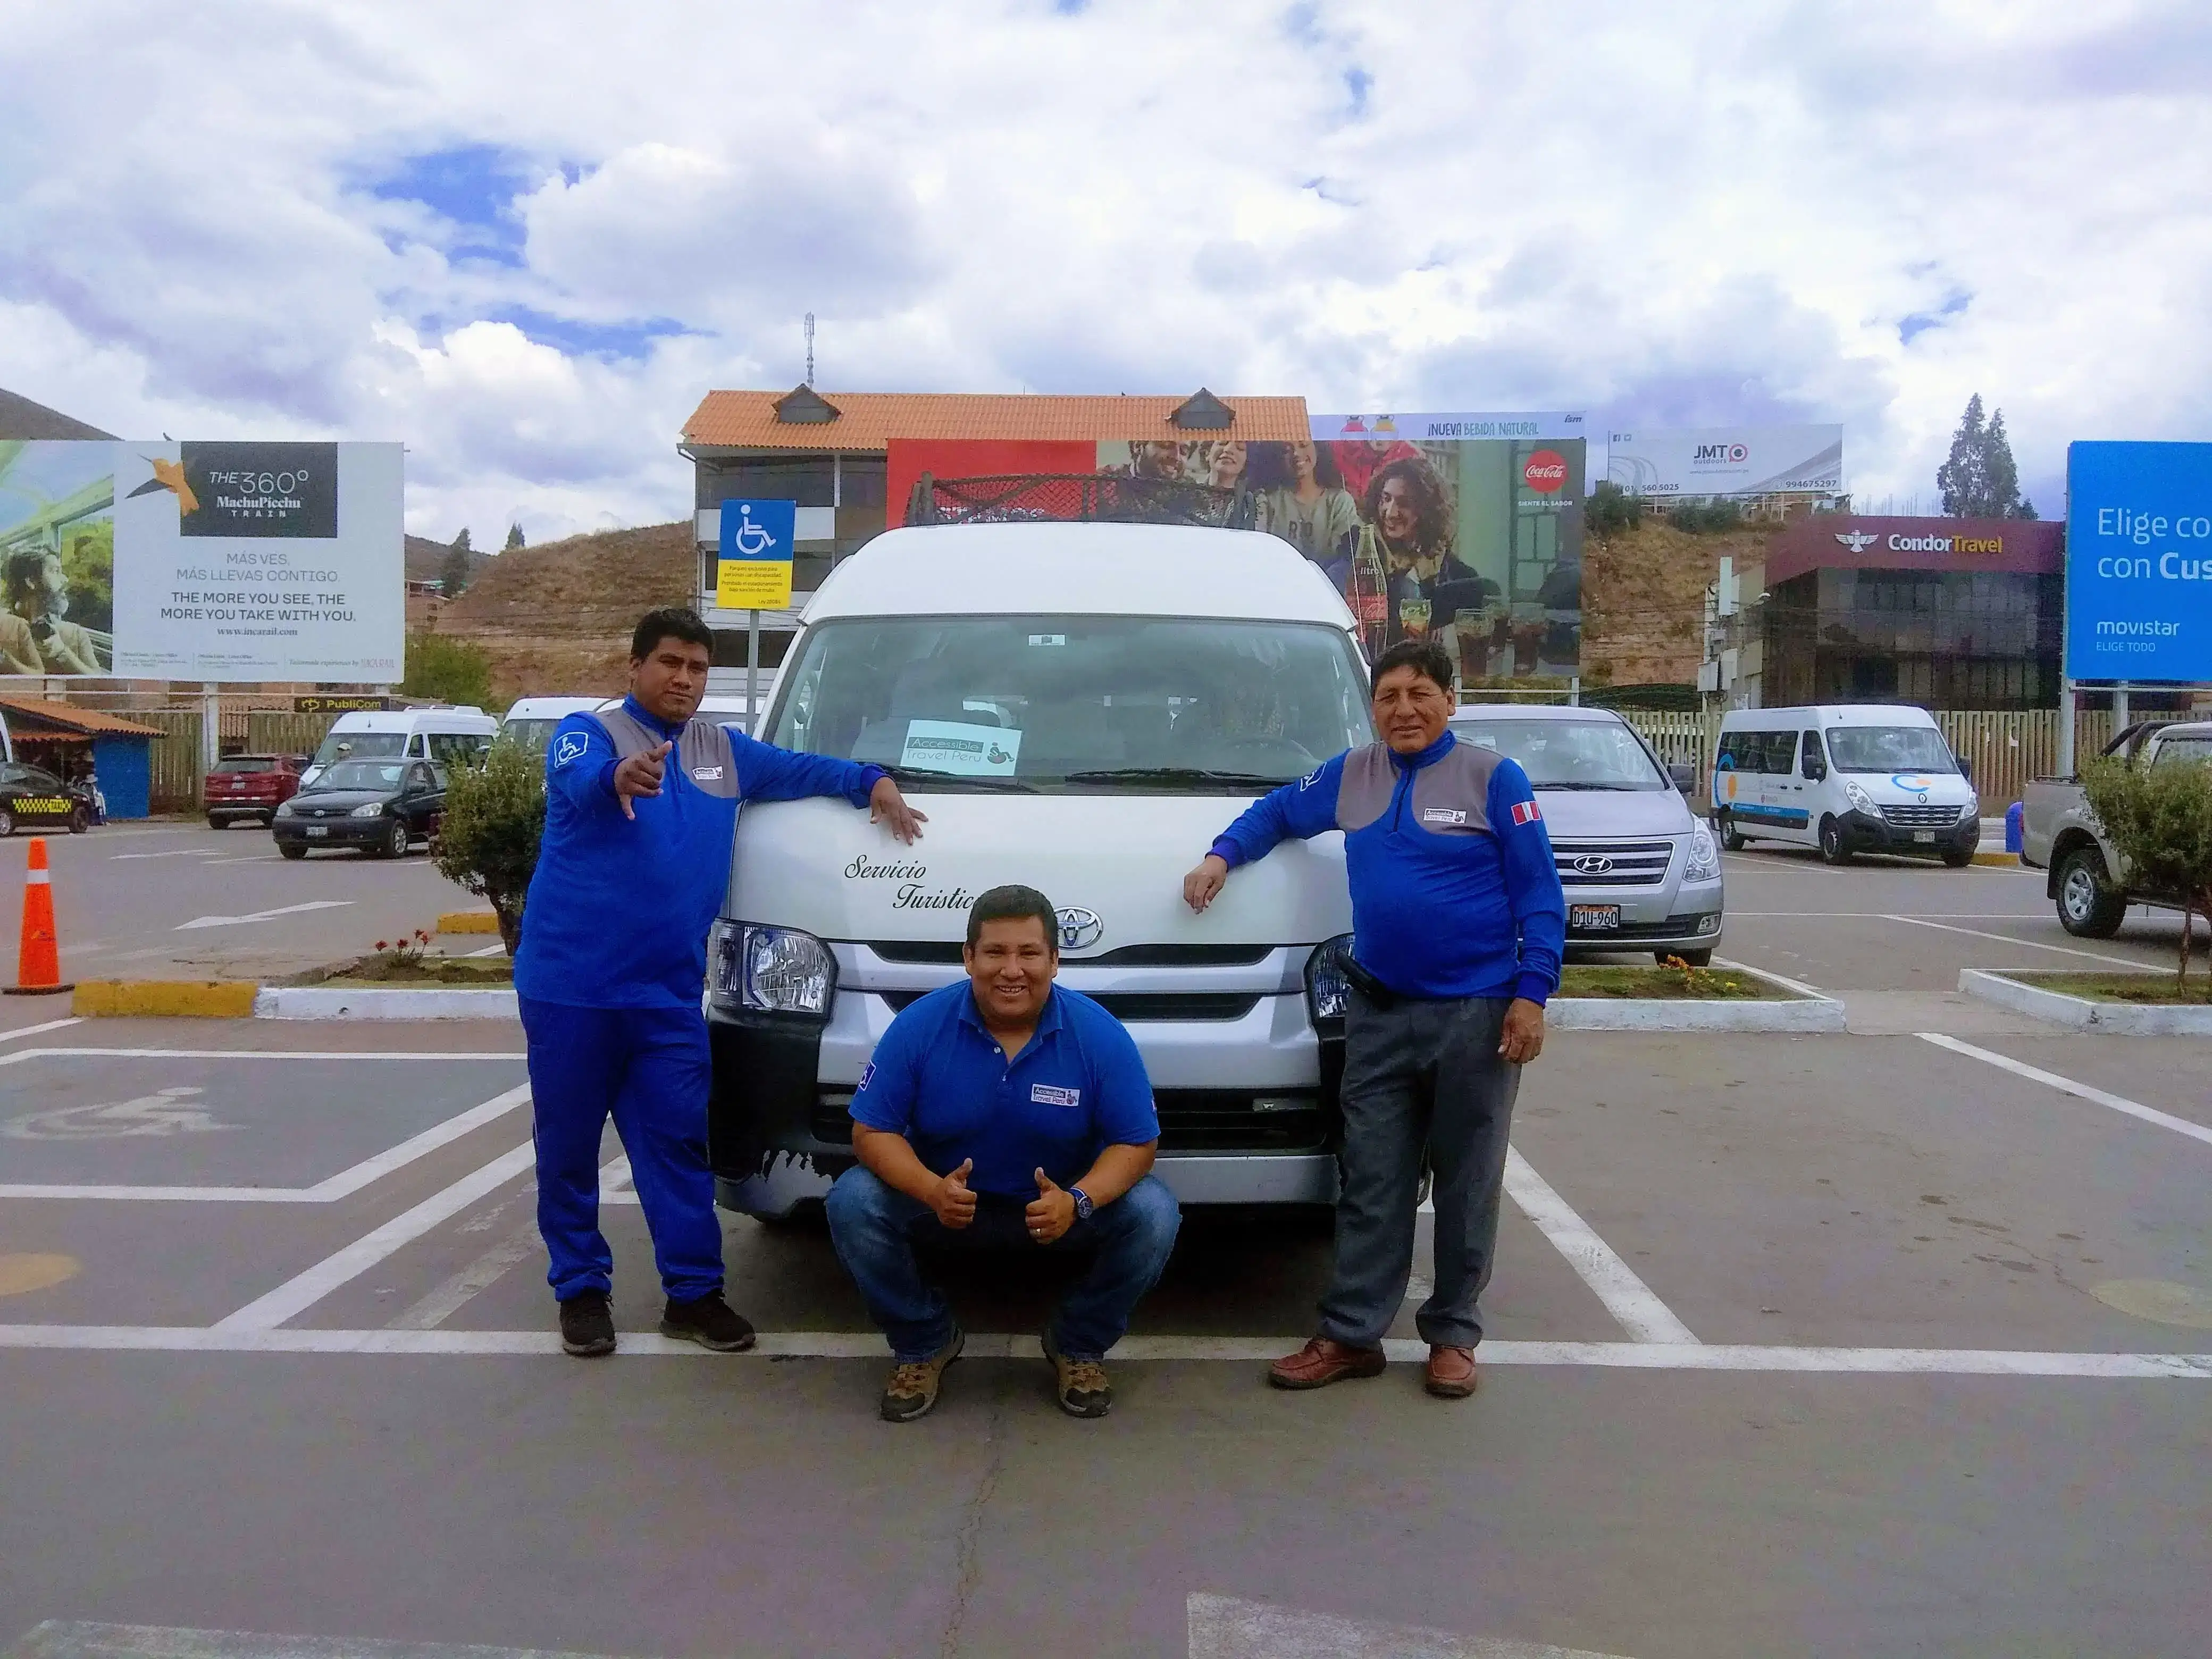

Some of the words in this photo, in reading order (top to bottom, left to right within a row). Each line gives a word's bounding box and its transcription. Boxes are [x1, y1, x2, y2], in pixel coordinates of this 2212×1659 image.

[1464, 423, 1495, 436] BEBIDA
[1499, 422, 1539, 435] NATURAL
[1694, 445, 1728, 458] JMT
[210, 472, 239, 484] THE
[1526, 465, 1566, 478] Coca-Cola
[1786, 480, 1837, 488] 994675297
[216, 496, 301, 508] MachuPicchu
[2098, 508, 2168, 545] Elige
[227, 551, 257, 564] MÁS
[177, 566, 207, 581] MÁS
[211, 569, 263, 581] LLEVAS
[2098, 557, 2150, 579] con
[171, 592, 199, 603] THE
[203, 592, 245, 604] MORE
[249, 593, 279, 604] YOU
[316, 594, 346, 605] THE
[160, 608, 203, 619] MORE
[205, 609, 236, 620] YOU
[238, 609, 275, 621] TAKE
[278, 610, 320, 621] WITH
[323, 610, 356, 622] YOU.
[217, 627, 298, 636] www.incarail.com
[2097, 621, 2180, 636] movistar
[2096, 642, 2124, 652] ELIGE
[2127, 642, 2156, 652] TODO
[326, 699, 382, 709] PubliCom
[911, 738, 979, 750] Accessible
[907, 749, 947, 760] Travel
[952, 751, 981, 762] Peru
[844, 854, 926, 878] Servicio
[893, 884, 974, 909] Turistic
[1573, 911, 1617, 925] D1U-960
[1033, 1094, 1051, 1102] Travel
[1035, 1087, 1065, 1097] Accessible
